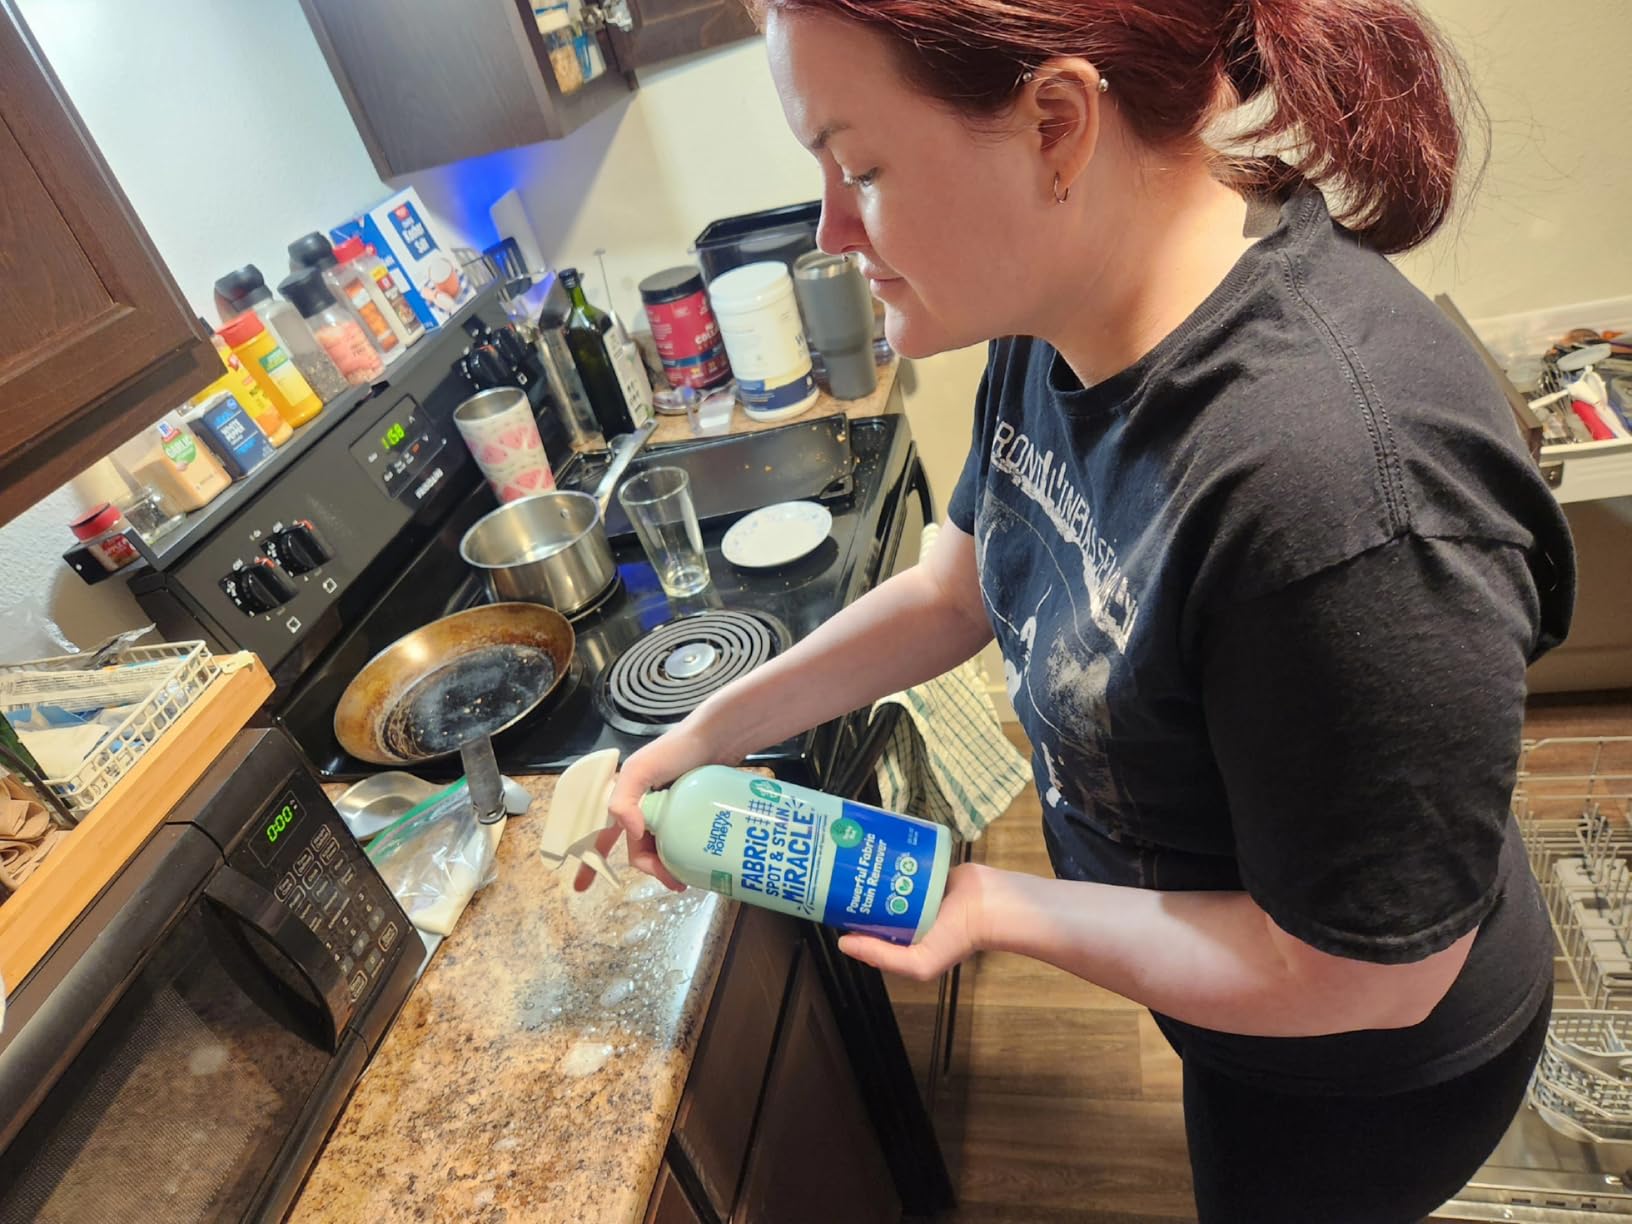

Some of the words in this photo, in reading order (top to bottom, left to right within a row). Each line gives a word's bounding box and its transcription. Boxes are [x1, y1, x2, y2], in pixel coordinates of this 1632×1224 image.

[266, 805, 293, 842] 0:00
[706, 814, 724, 851] sunny
[712, 819, 733, 857] honey
[772, 808, 790, 848] STAIN
[771, 850, 784, 863] &
[847, 867, 868, 914] Powerful
[859, 833, 877, 868] Fabric
[867, 839, 888, 887] Remover
[766, 866, 782, 897] SPOT
[860, 887, 877, 915] Stain
